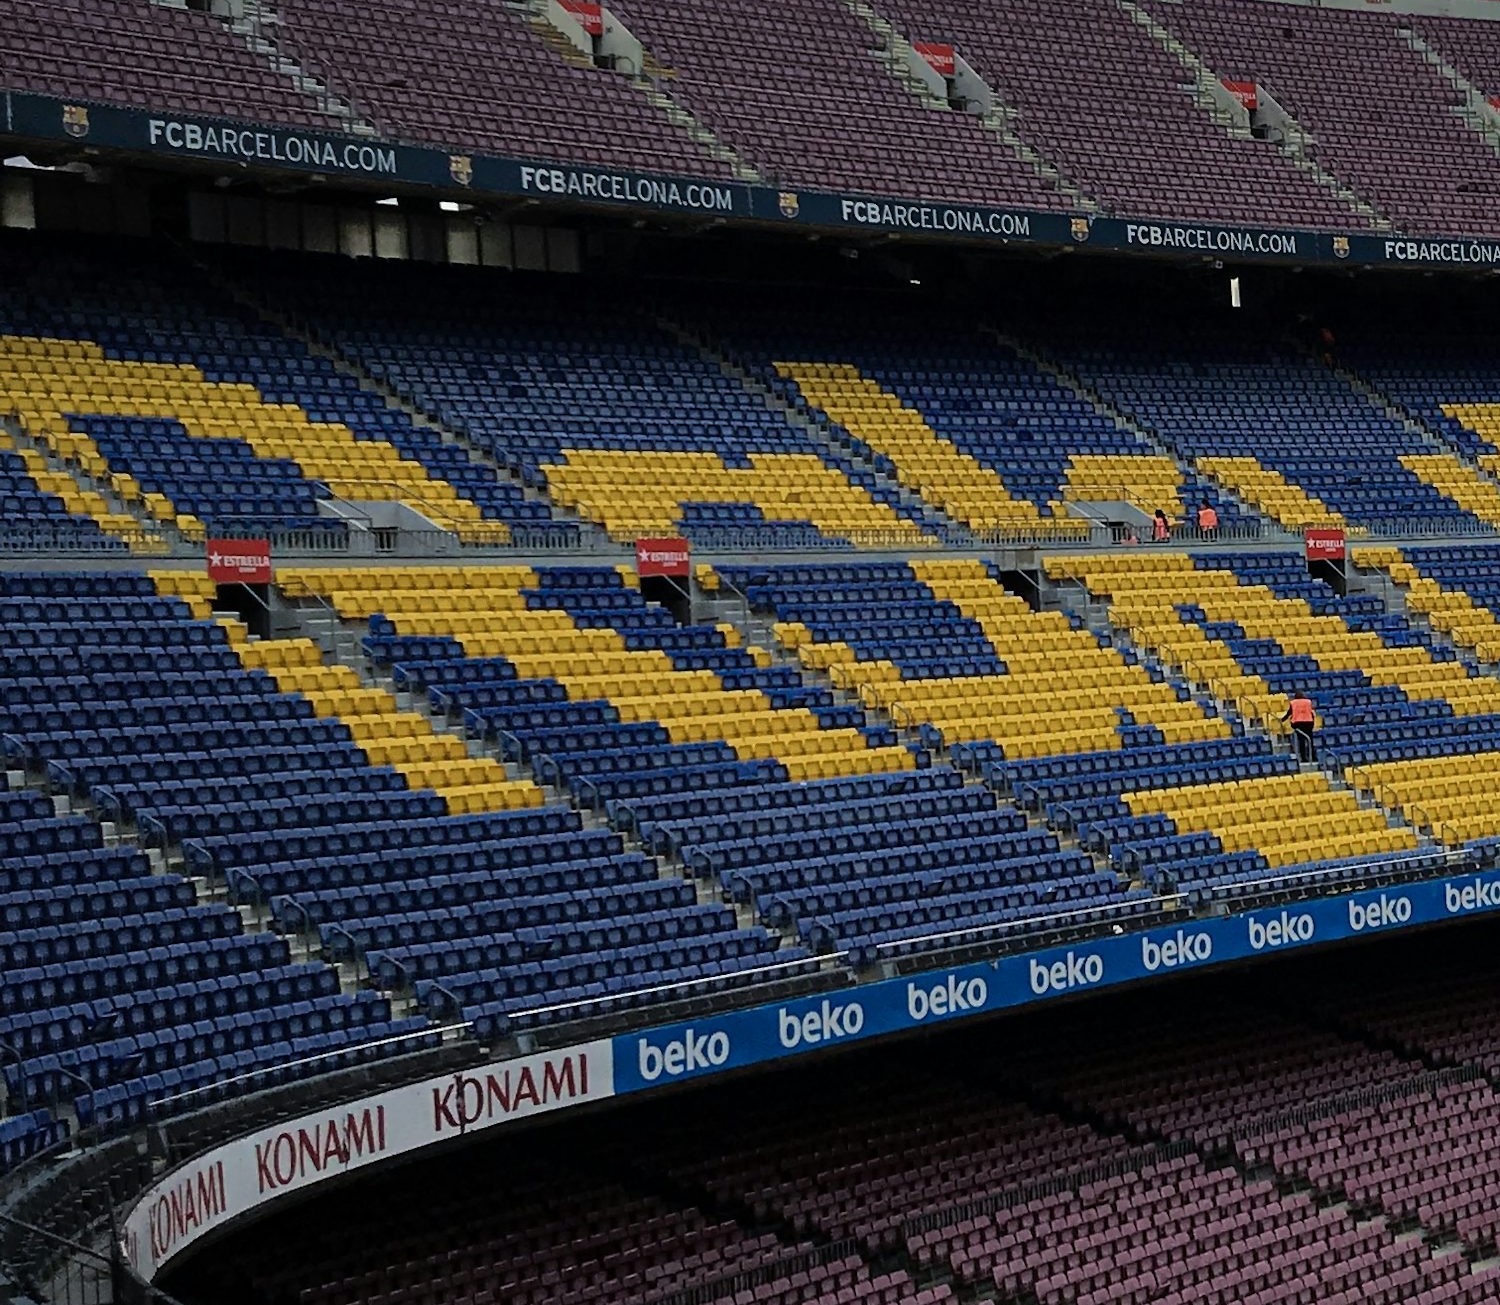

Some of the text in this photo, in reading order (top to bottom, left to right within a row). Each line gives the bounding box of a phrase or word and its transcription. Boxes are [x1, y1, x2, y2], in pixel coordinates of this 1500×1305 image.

[150, 120, 396, 174] FCBARCELONA.COM
[520, 167, 733, 210] FCBARCELONA.COM
[841, 200, 1030, 236] FCBARCELONA.COM
[1126, 225, 1297, 254] FCBARCELONA.COM
[1248, 911, 1314, 950] beko
[1349, 894, 1411, 931] beko
[1143, 930, 1212, 971] beko
[1029, 952, 1103, 994] beko
[907, 974, 987, 1020] beko
[779, 1001, 864, 1048] beko
[639, 1029, 730, 1081] beko
[432, 1053, 590, 1133] KONAMI
[255, 1106, 386, 1194] KONAMI
[150, 1160, 227, 1259] KONAMI
